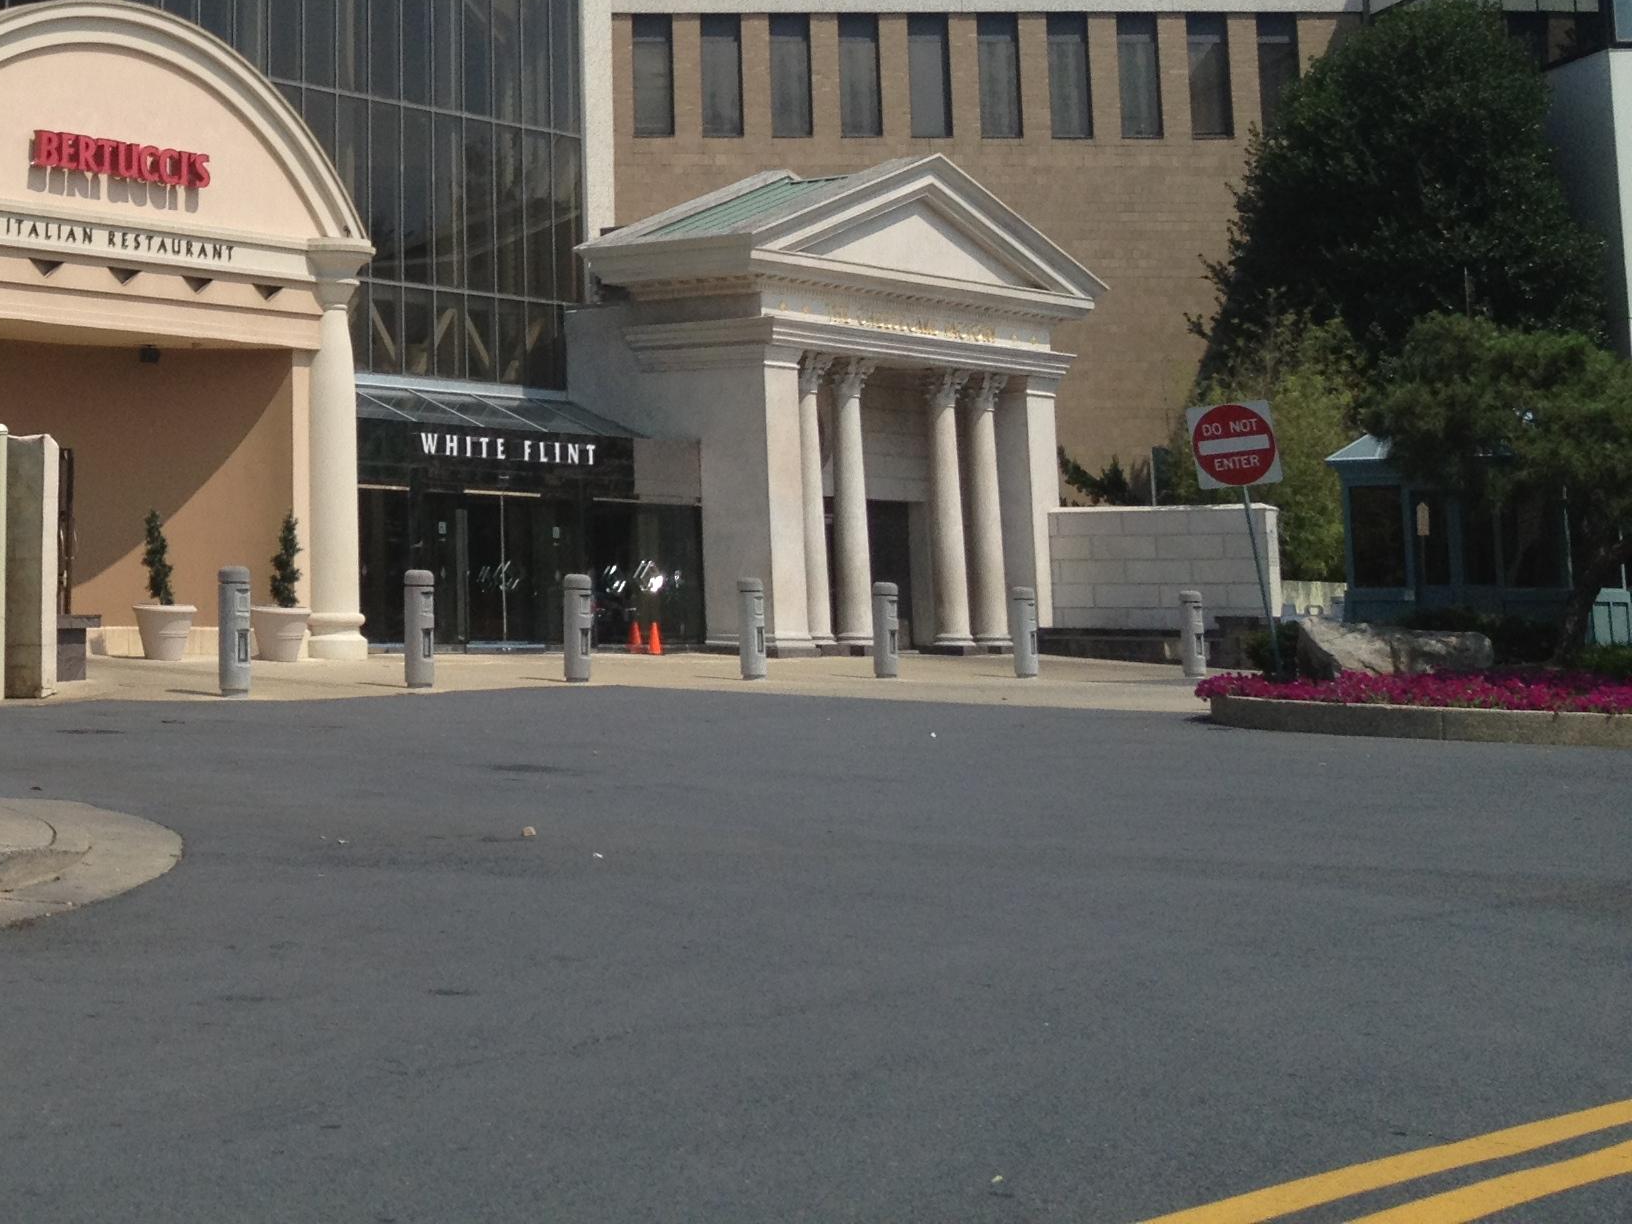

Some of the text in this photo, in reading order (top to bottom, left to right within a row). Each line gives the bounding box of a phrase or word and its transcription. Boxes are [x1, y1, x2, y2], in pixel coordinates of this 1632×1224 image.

[33, 129, 211, 189] BERTUCCI'S
[5, 216, 236, 262] ITALIAN RESTAURANT
[1202, 419, 1258, 436] DO NOT
[420, 432, 596, 465] WHITE FLINT
[1214, 455, 1260, 471] ENTER
